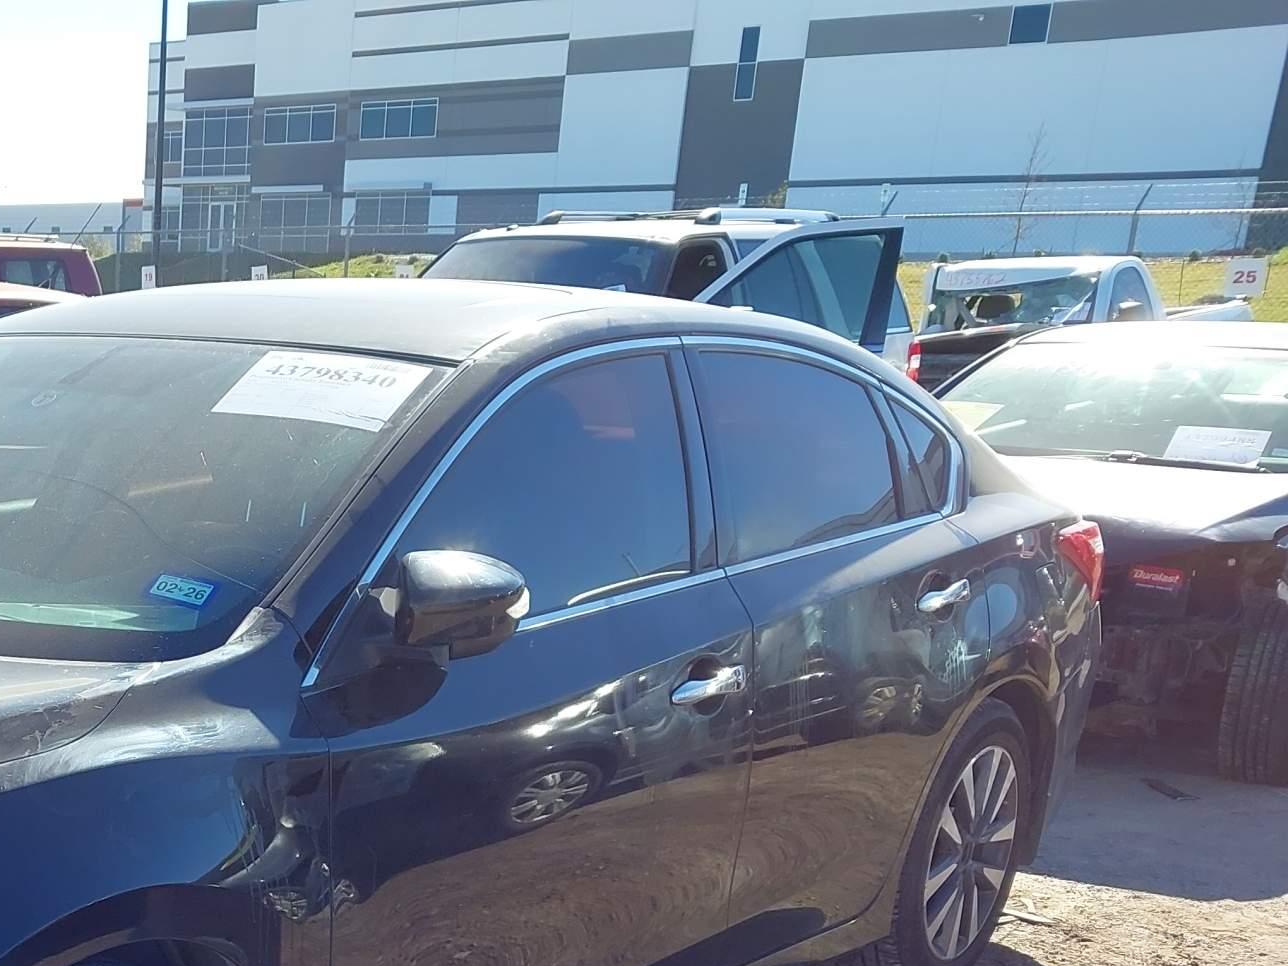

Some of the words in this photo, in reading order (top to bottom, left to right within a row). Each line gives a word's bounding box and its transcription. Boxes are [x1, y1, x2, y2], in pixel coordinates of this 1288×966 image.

[1232, 270, 1257, 284] 25
[266, 364, 397, 388] 43798340
[1133, 569, 1180, 583] Duralast
